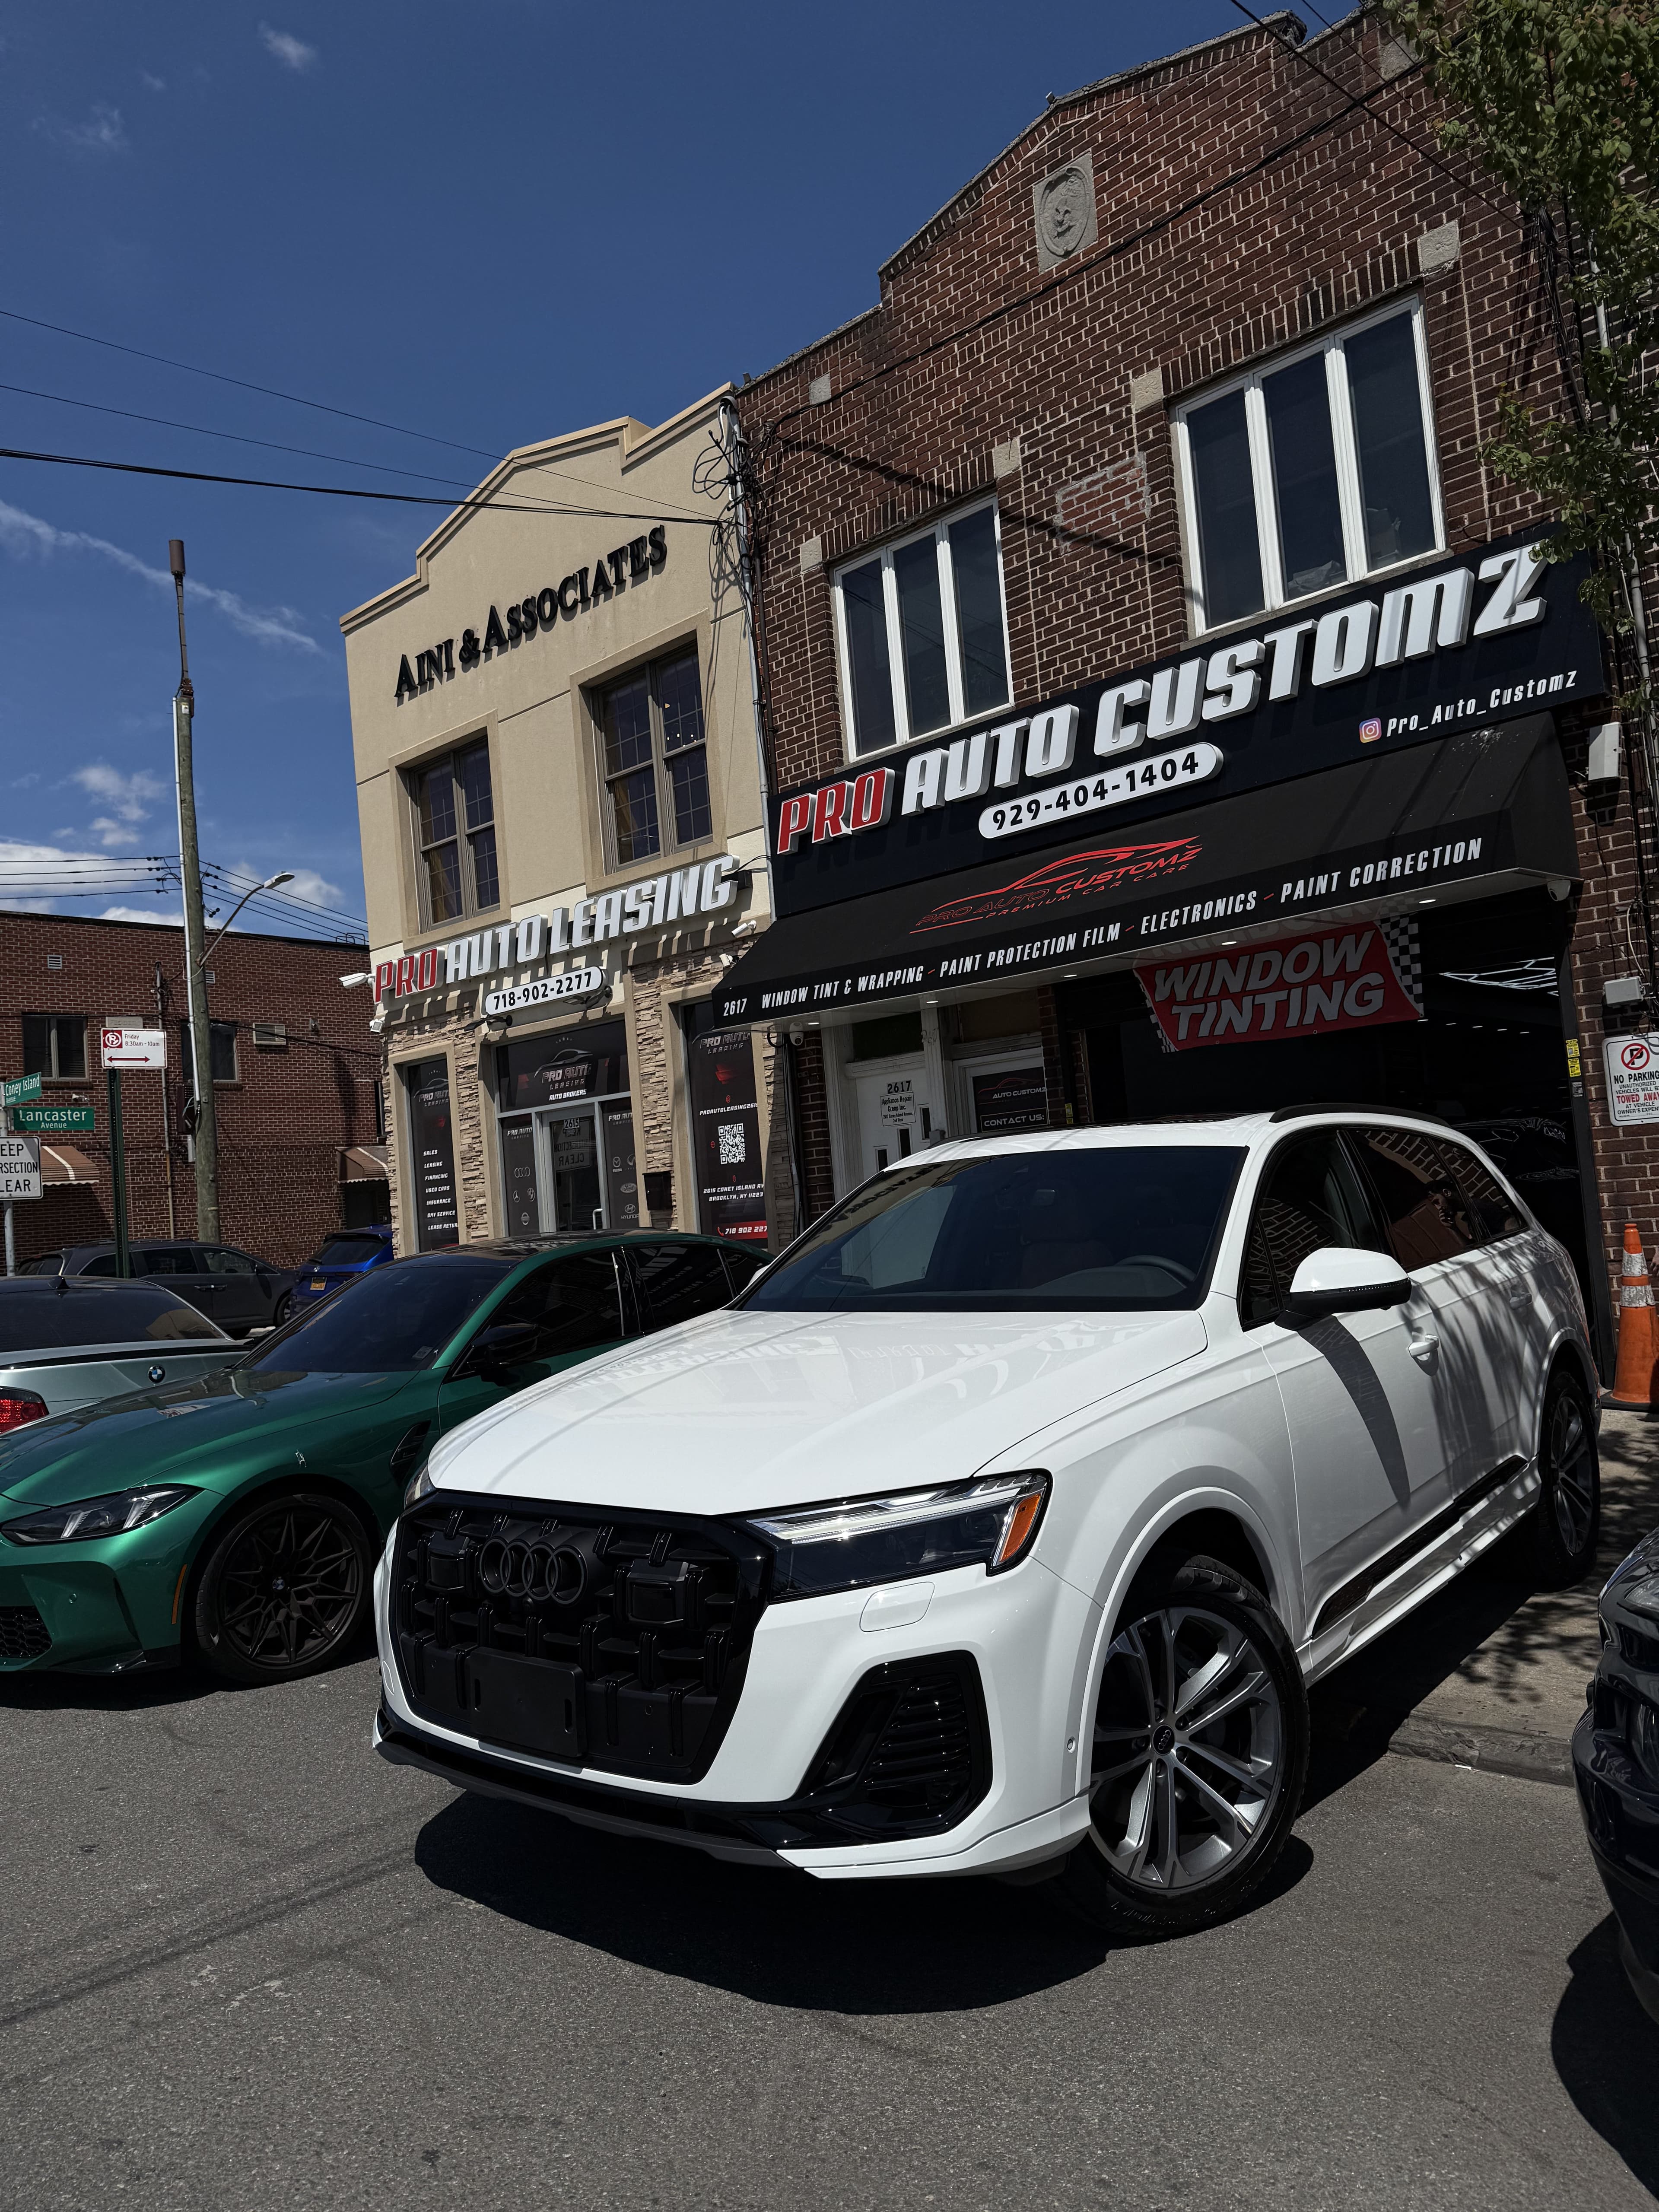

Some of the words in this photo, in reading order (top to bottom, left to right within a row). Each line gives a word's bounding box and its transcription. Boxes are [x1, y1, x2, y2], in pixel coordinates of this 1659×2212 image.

[459, 629, 480, 664] &
[482, 525, 667, 653] ASSOCIATES
[778, 767, 894, 855] PRO
[902, 704, 1080, 816] AUTO
[1094, 541, 1548, 756] CUSTOMZ
[1387, 670, 1577, 737] Pro_Auto_Customz
[992, 752, 1198, 830] 929-404-1404
[916, 906, 973, 927] PRO
[973, 889, 1050, 914] AUTO
[1055, 847, 1203, 894] CUSTOMZ
[985, 894, 1071, 918] PREMIUM
[1082, 881, 1122, 895] CAR
[1133, 864, 1189, 882] CARE
[375, 947, 445, 1004] PRO
[446, 914, 548, 984] AUTO
[550, 854, 740, 955] LEASING
[723, 998, 747, 1017] 2617
[762, 985, 809, 1009] WINDOW
[813, 981, 840, 1001] TINT
[844, 979, 852, 994] &
[857, 966, 925, 992] WRAPPING
[940, 954, 982, 978] PAINT
[987, 933, 1076, 968] PROTECTION
[1083, 923, 1122, 947] FILM
[1140, 891, 1257, 935] ELECTRONICS
[1280, 871, 1340, 903] PAINT
[1349, 837, 1482, 888] CORRECTION
[1154, 929, 1376, 1003] WINDOW
[494, 971, 592, 1011] 718-902-2277
[1171, 972, 1385, 1041] TINTING
[700, 1036, 721, 1049] PRO
[708, 1043, 744, 1054] LEASING
[542, 1069, 563, 1084] PRO
[564, 1064, 592, 1079] AUTO
[1614, 1075, 1624, 1084] NO
[1628, 1070, 1659, 1083] PARKING
[5, 1082, 21, 1096] Coney
[23, 1074, 40, 1091] Island
[434, 1089, 449, 1100] AUT
[549, 1093, 563, 1101] AUTO
[563, 1089, 587, 1098] BROKERS
[887, 1080, 911, 1094] 2617
[1012, 1087, 1047, 1096] CUSTOMZ
[899, 1095, 913, 1103] Repair
[1616, 1093, 1640, 1104] TOWED
[19, 1109, 86, 1121] Lancaster
[564, 1118, 580, 1128] 2615
[984, 1116, 1027, 1127] CONTACT
